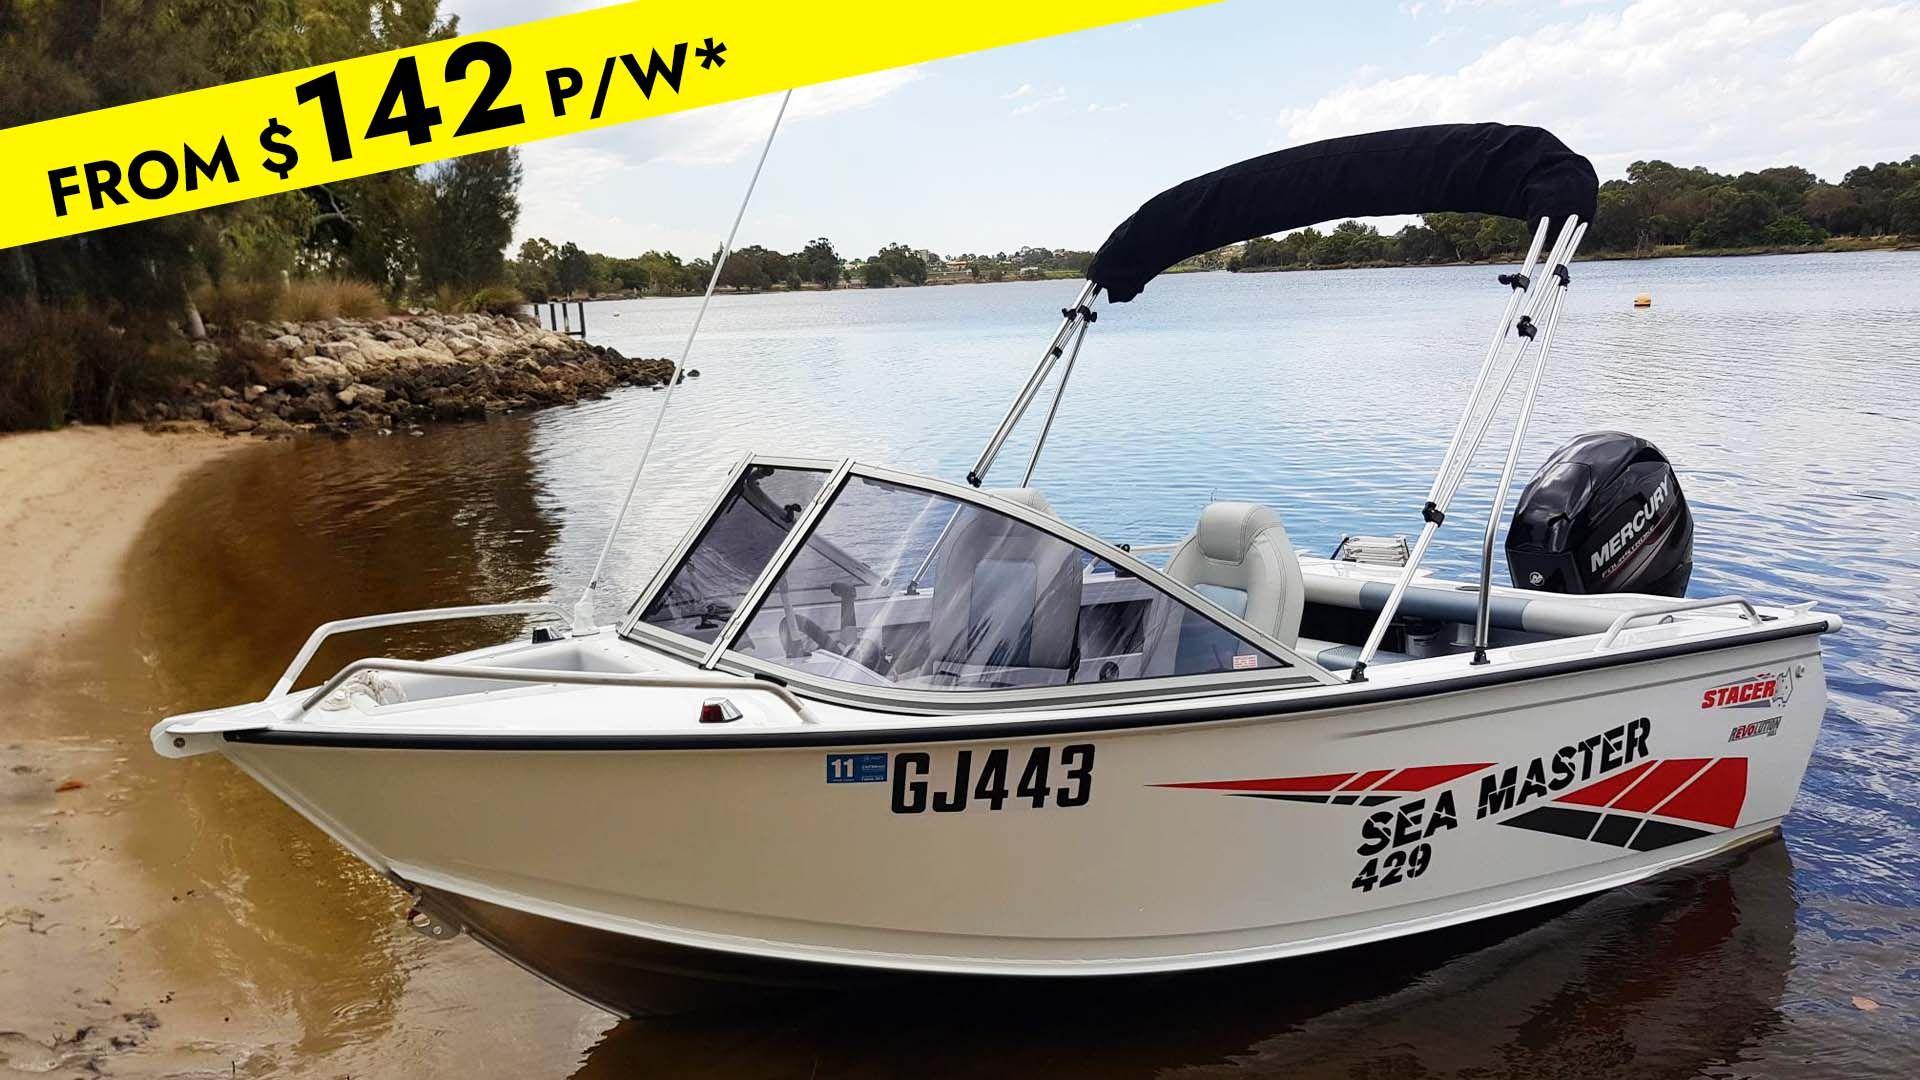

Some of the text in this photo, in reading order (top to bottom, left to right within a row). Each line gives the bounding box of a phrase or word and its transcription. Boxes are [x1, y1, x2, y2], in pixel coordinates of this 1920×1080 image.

[1590, 474, 1670, 573] MERCURY
[1701, 680, 1776, 709] STACER
[1728, 716, 1782, 742] REVOLUTION
[831, 758, 854, 778] 11
[891, 744, 1096, 814] GJ443
[1357, 717, 1651, 856] SEA MASTER
[1351, 843, 1432, 893] 429
